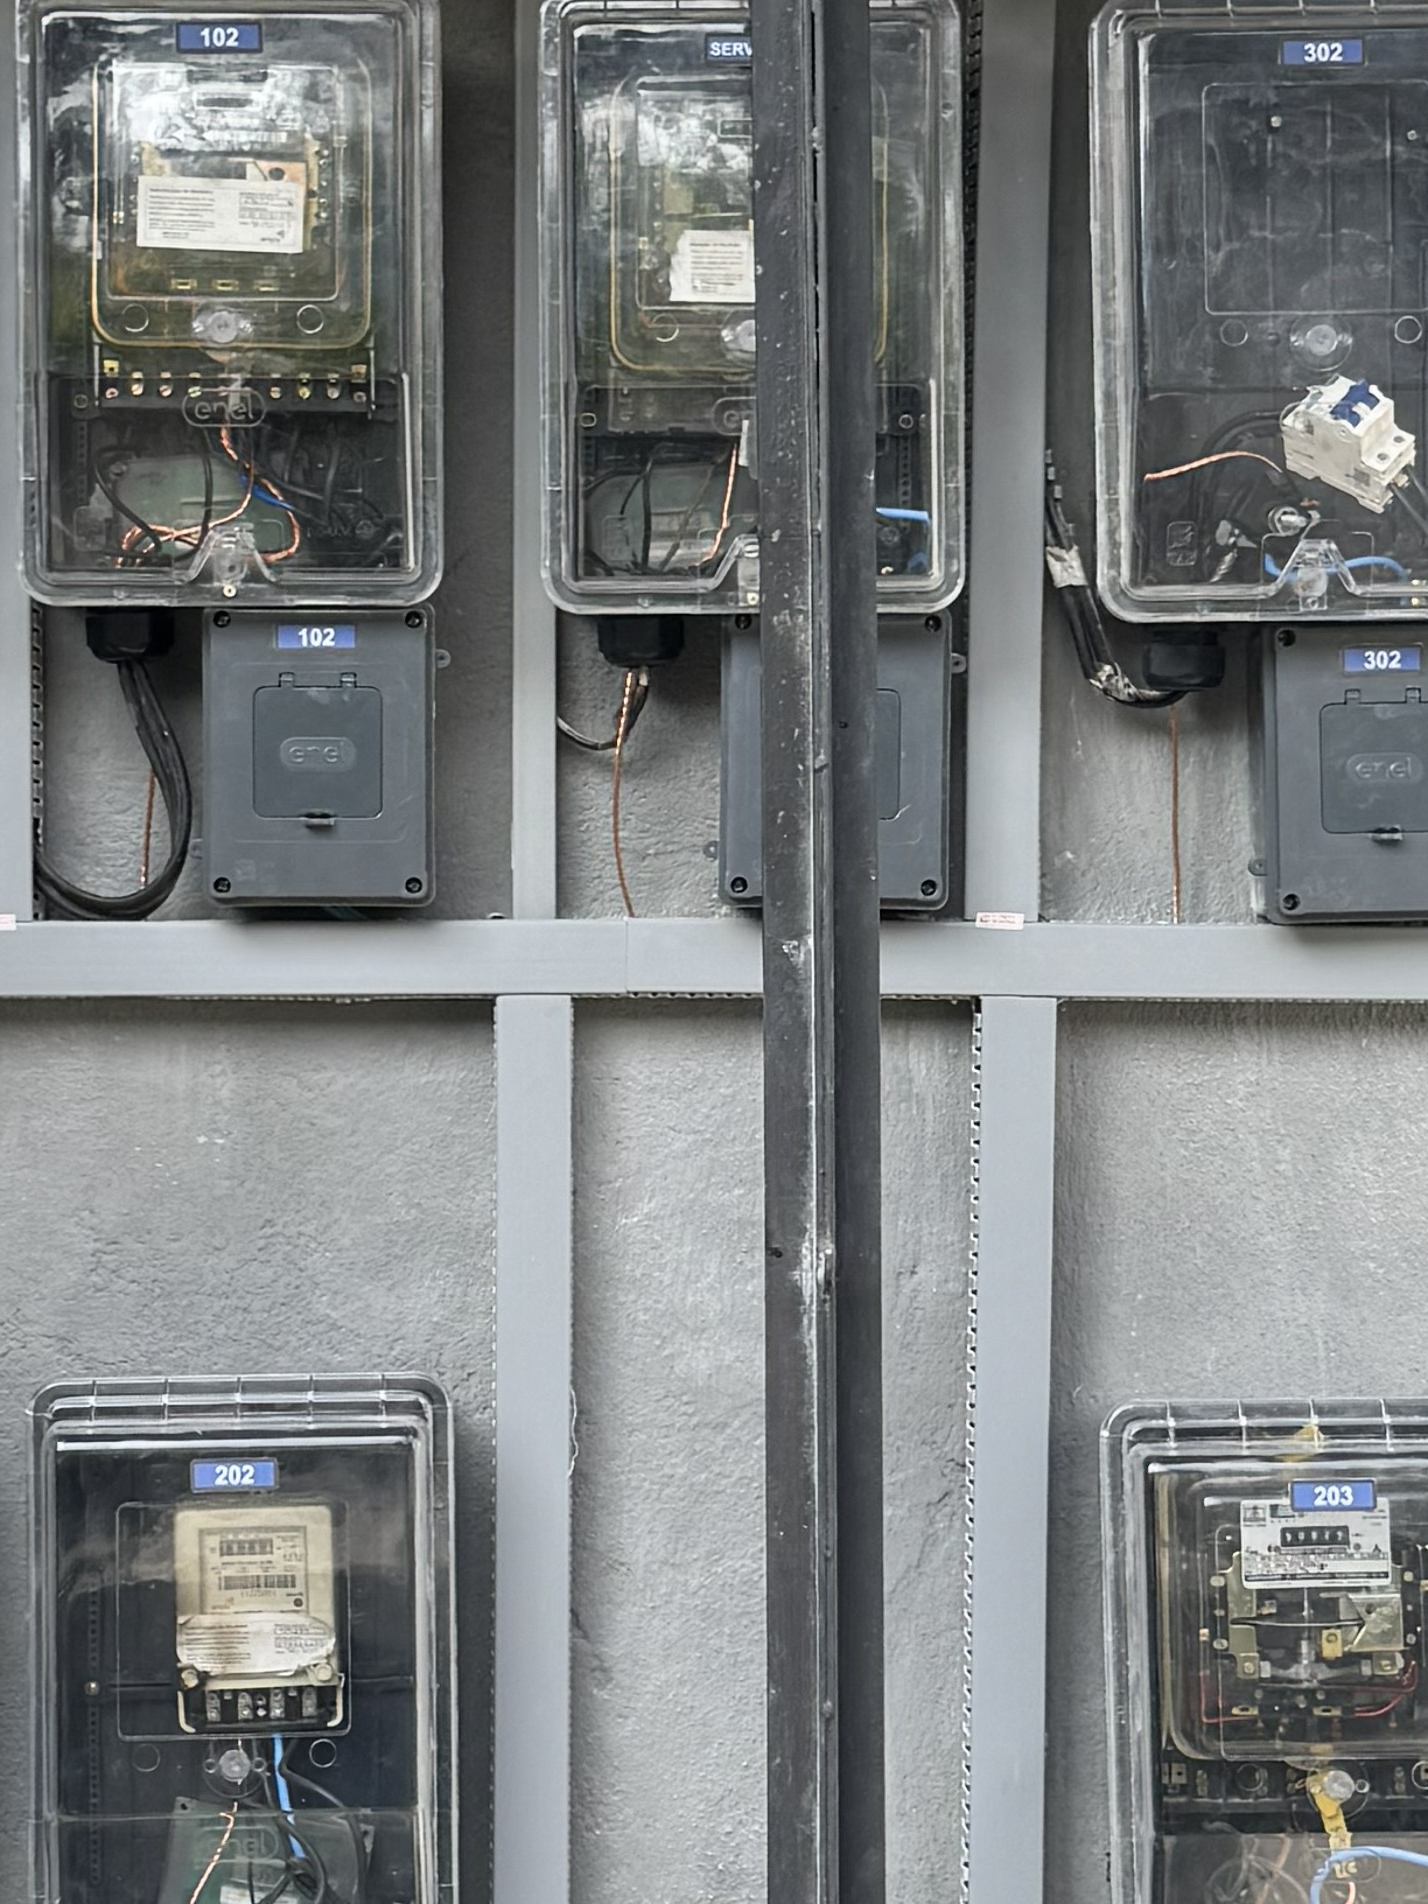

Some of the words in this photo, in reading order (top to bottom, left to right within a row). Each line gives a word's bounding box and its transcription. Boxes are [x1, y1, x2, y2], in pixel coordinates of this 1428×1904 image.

[200, 27, 239, 47] 102
[1303, 42, 1343, 63] 302
[193, 394, 254, 421] enel
[298, 627, 336, 648] 102
[1363, 650, 1402, 670] 302
[1354, 756, 1413, 778] enel
[214, 1464, 255, 1486] 202
[1313, 1485, 1354, 1507] 203
